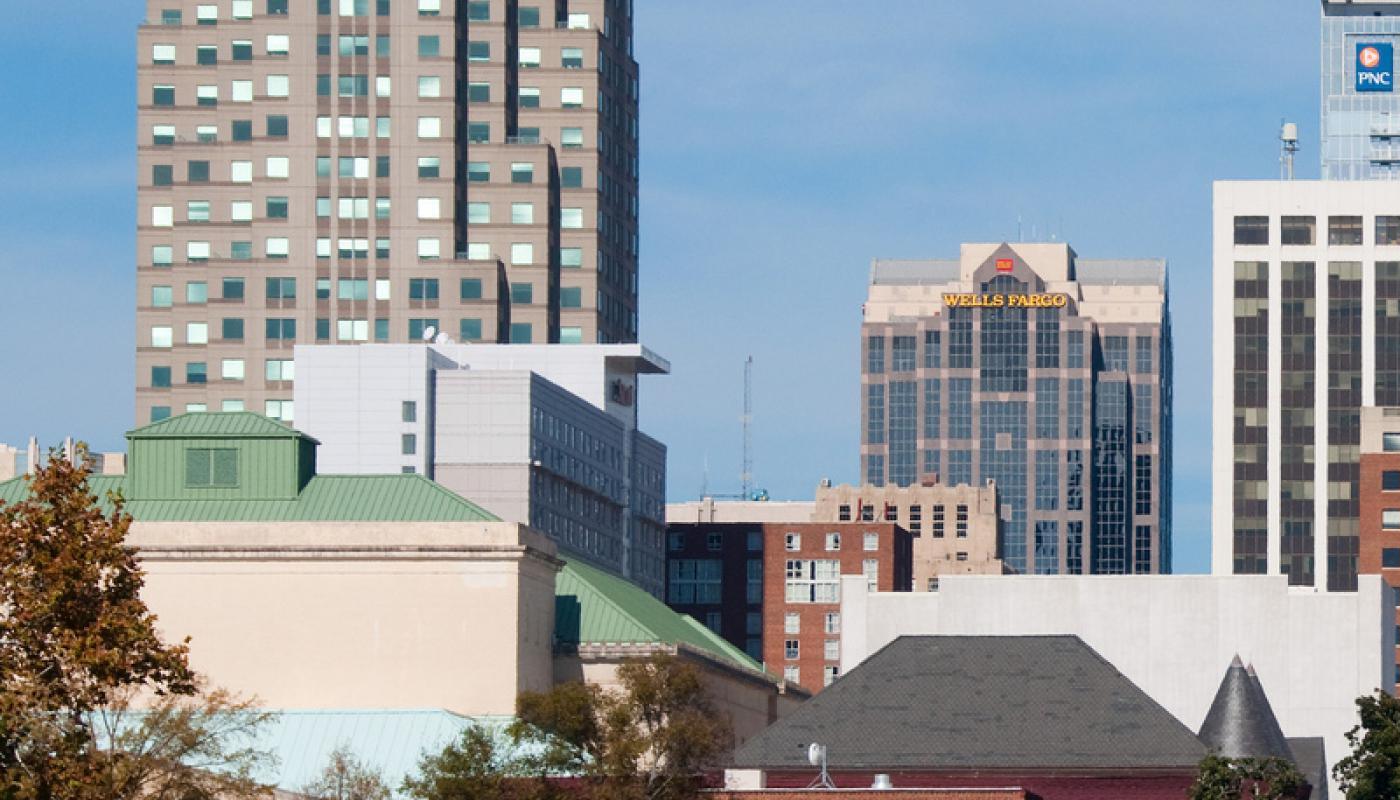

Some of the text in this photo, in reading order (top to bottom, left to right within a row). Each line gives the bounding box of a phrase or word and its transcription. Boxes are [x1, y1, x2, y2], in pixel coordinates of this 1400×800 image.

[1358, 72, 1390, 85] PNC
[943, 294, 1066, 307] WELLS FARGO
